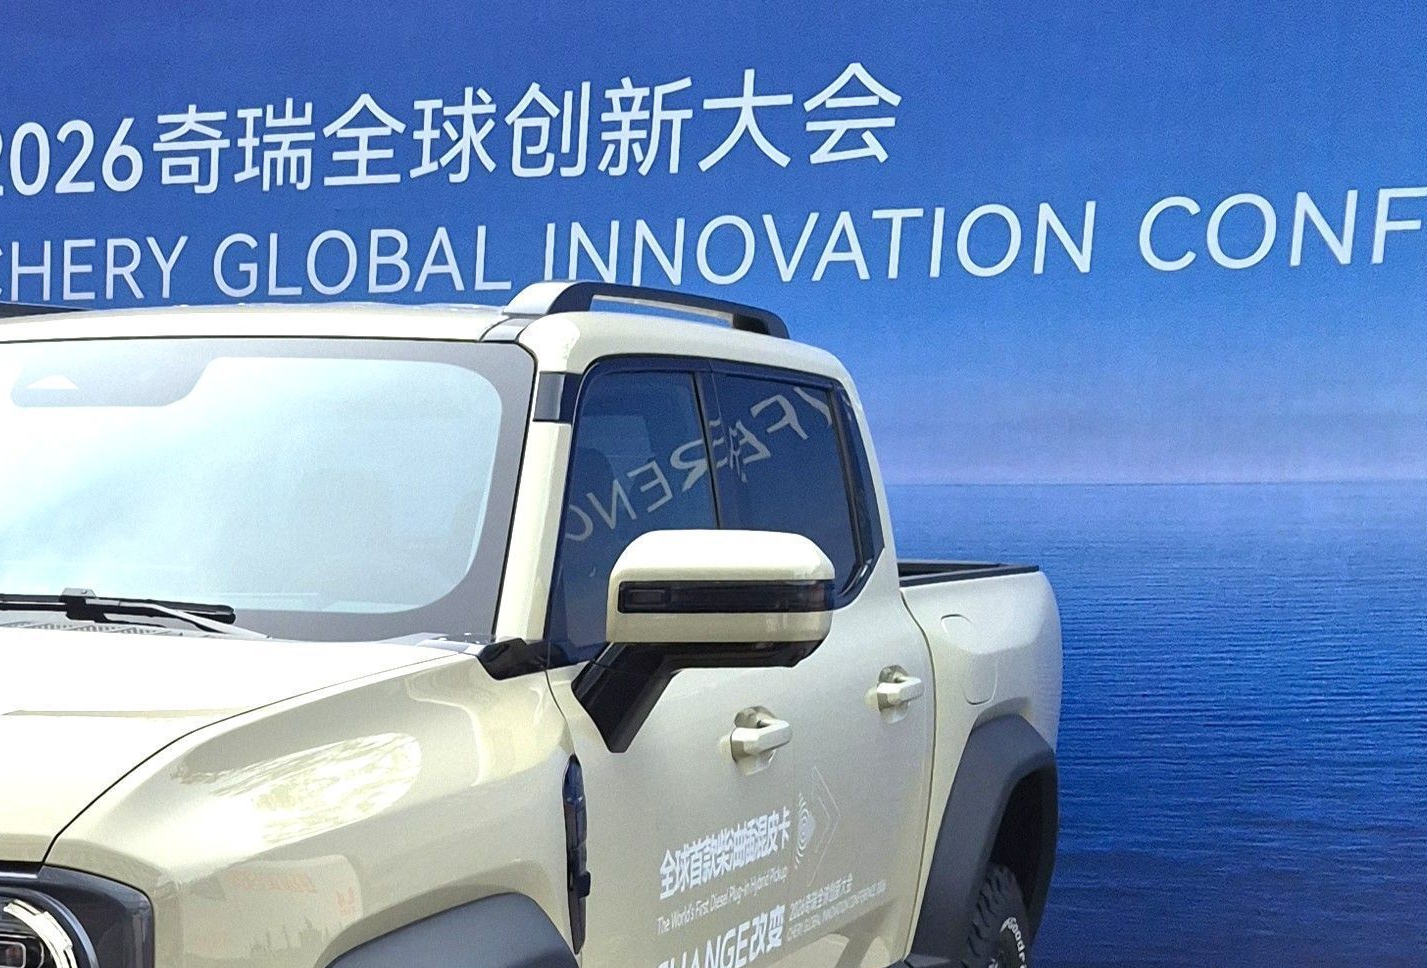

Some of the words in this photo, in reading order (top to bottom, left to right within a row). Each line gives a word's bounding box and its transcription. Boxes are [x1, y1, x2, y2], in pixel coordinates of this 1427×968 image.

[213, 224, 512, 299] GLOBAL
[543, 200, 1097, 286] INNOVATION
[1138, 185, 1427, 272] CONF
